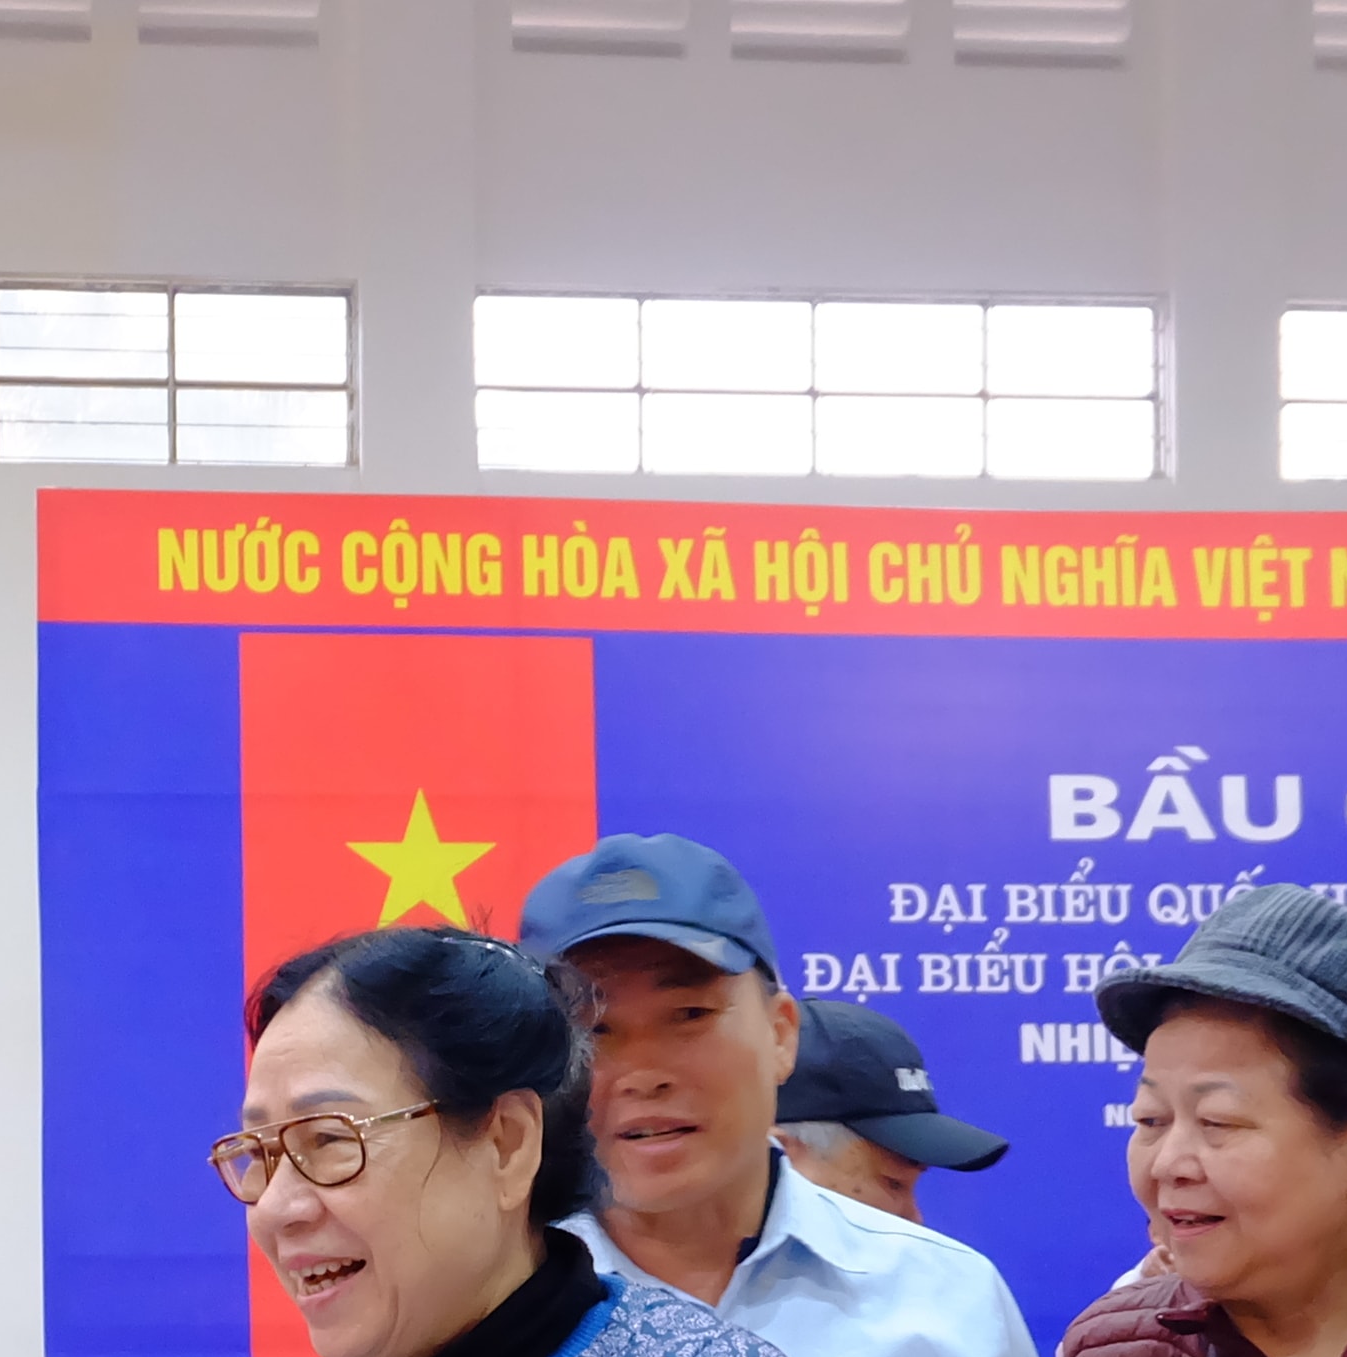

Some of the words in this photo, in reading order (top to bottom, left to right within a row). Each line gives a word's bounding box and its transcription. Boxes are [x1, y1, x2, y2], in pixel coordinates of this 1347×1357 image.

[158, 517, 320, 594] NƯỚC
[342, 519, 502, 609] CỘNG
[522, 520, 640, 599] HÒA
[658, 526, 736, 601] XÃ
[754, 527, 849, 617] HỘI
[868, 523, 982, 606] CHỦ
[1000, 534, 1178, 608] NGHĨA
[1192, 534, 1313, 622] VIỆT
[1048, 745, 1302, 842] BẦU
[888, 883, 988, 933] ĐẠI
[1003, 857, 1132, 924] BIỂU
[802, 953, 902, 1003] ĐẠI
[917, 926, 1047, 994] BIỂU
